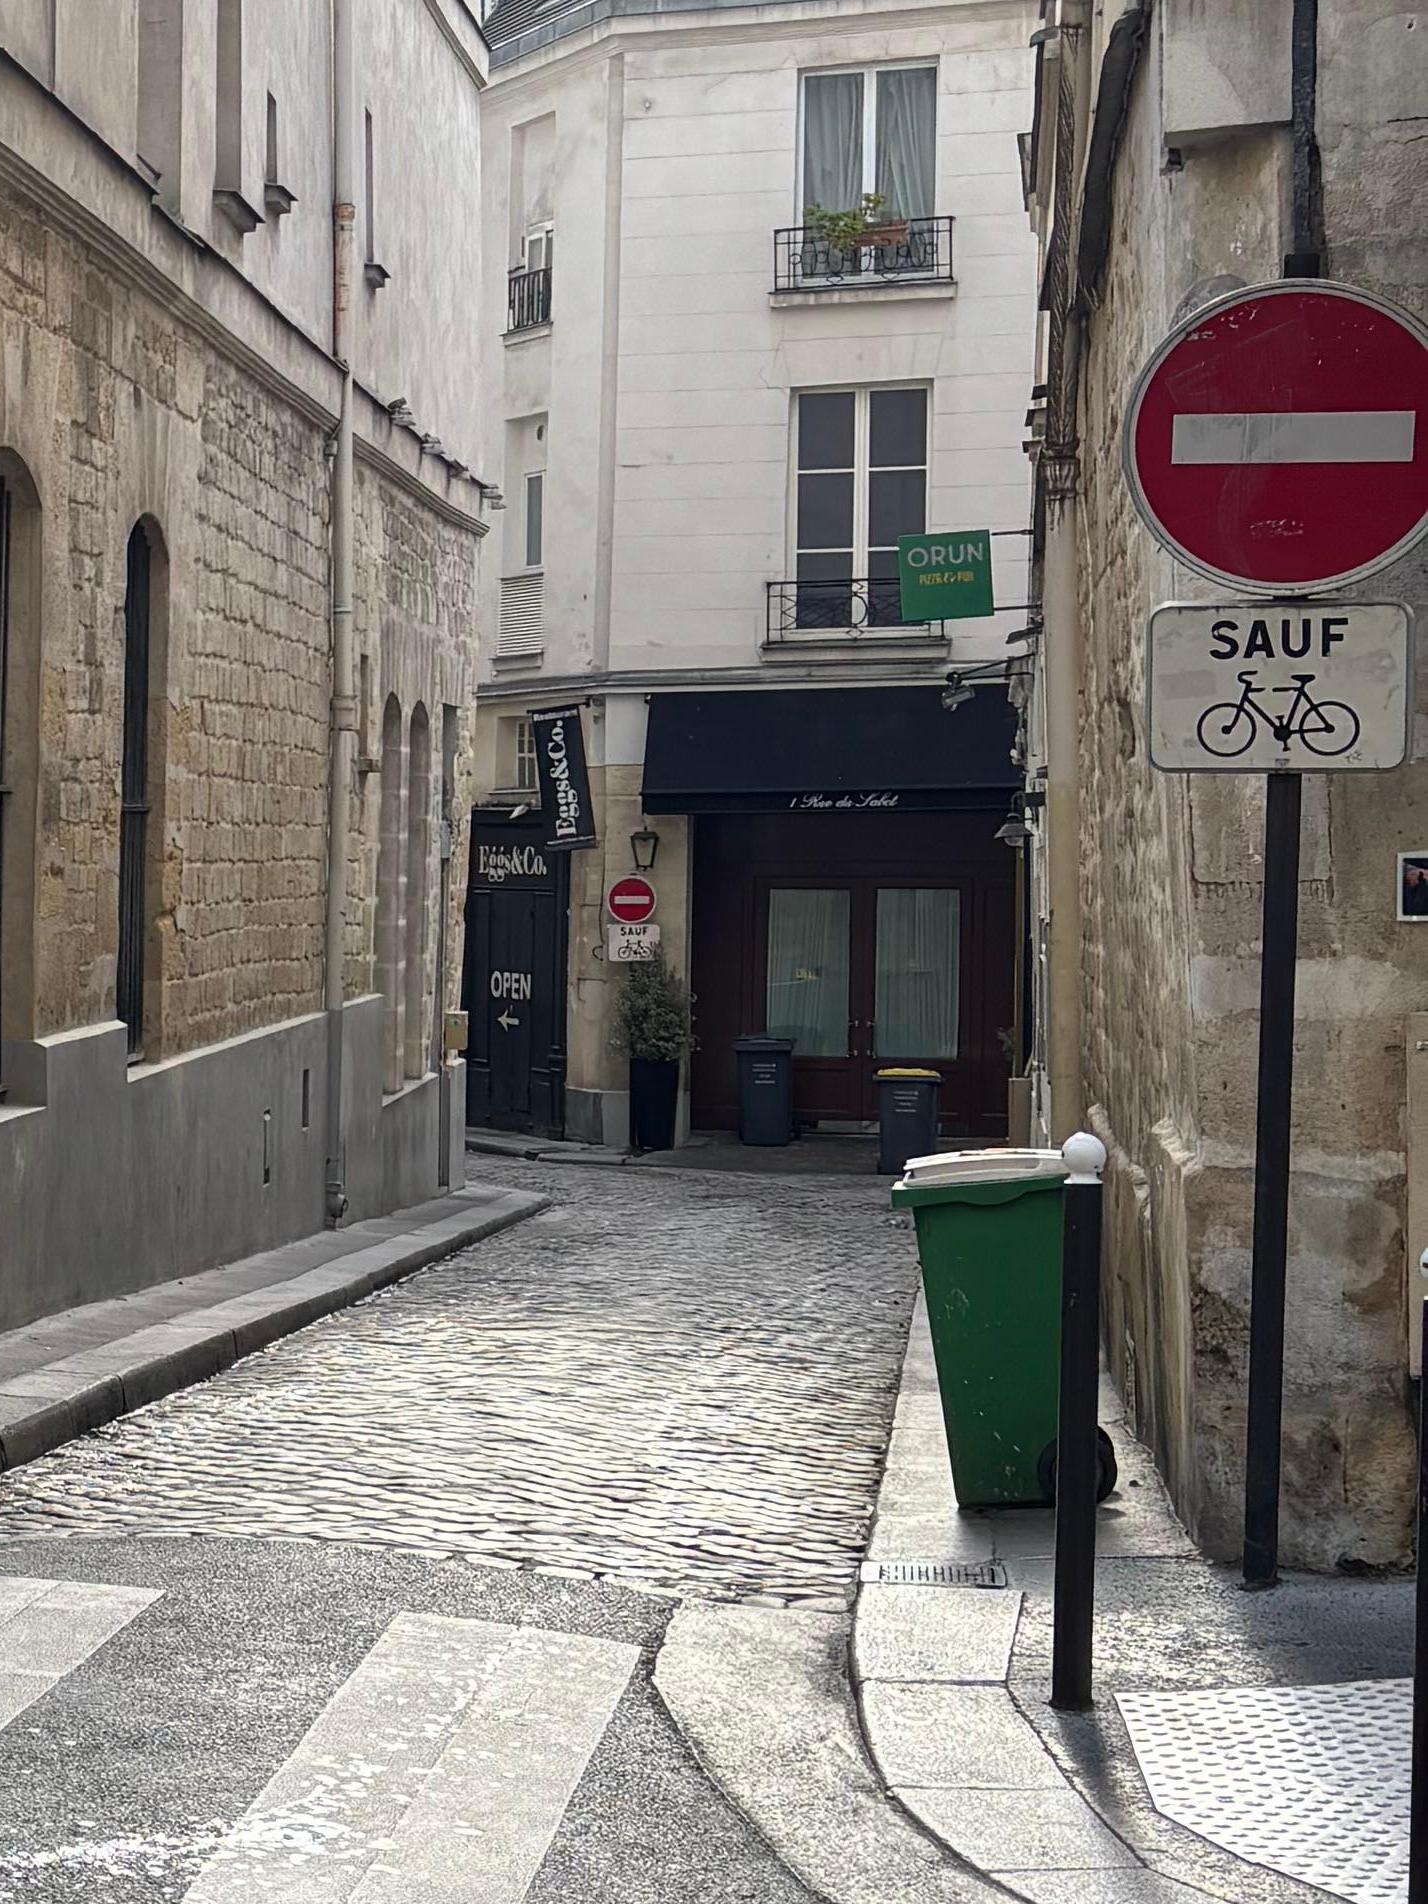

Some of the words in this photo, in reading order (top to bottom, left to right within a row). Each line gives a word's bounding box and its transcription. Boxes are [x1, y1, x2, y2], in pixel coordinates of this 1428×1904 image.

[907, 542, 984, 567] ORUN
[1209, 617, 1349, 660] SAUF
[620, 926, 649, 937] SAUF
[490, 970, 532, 1001] OPEN
